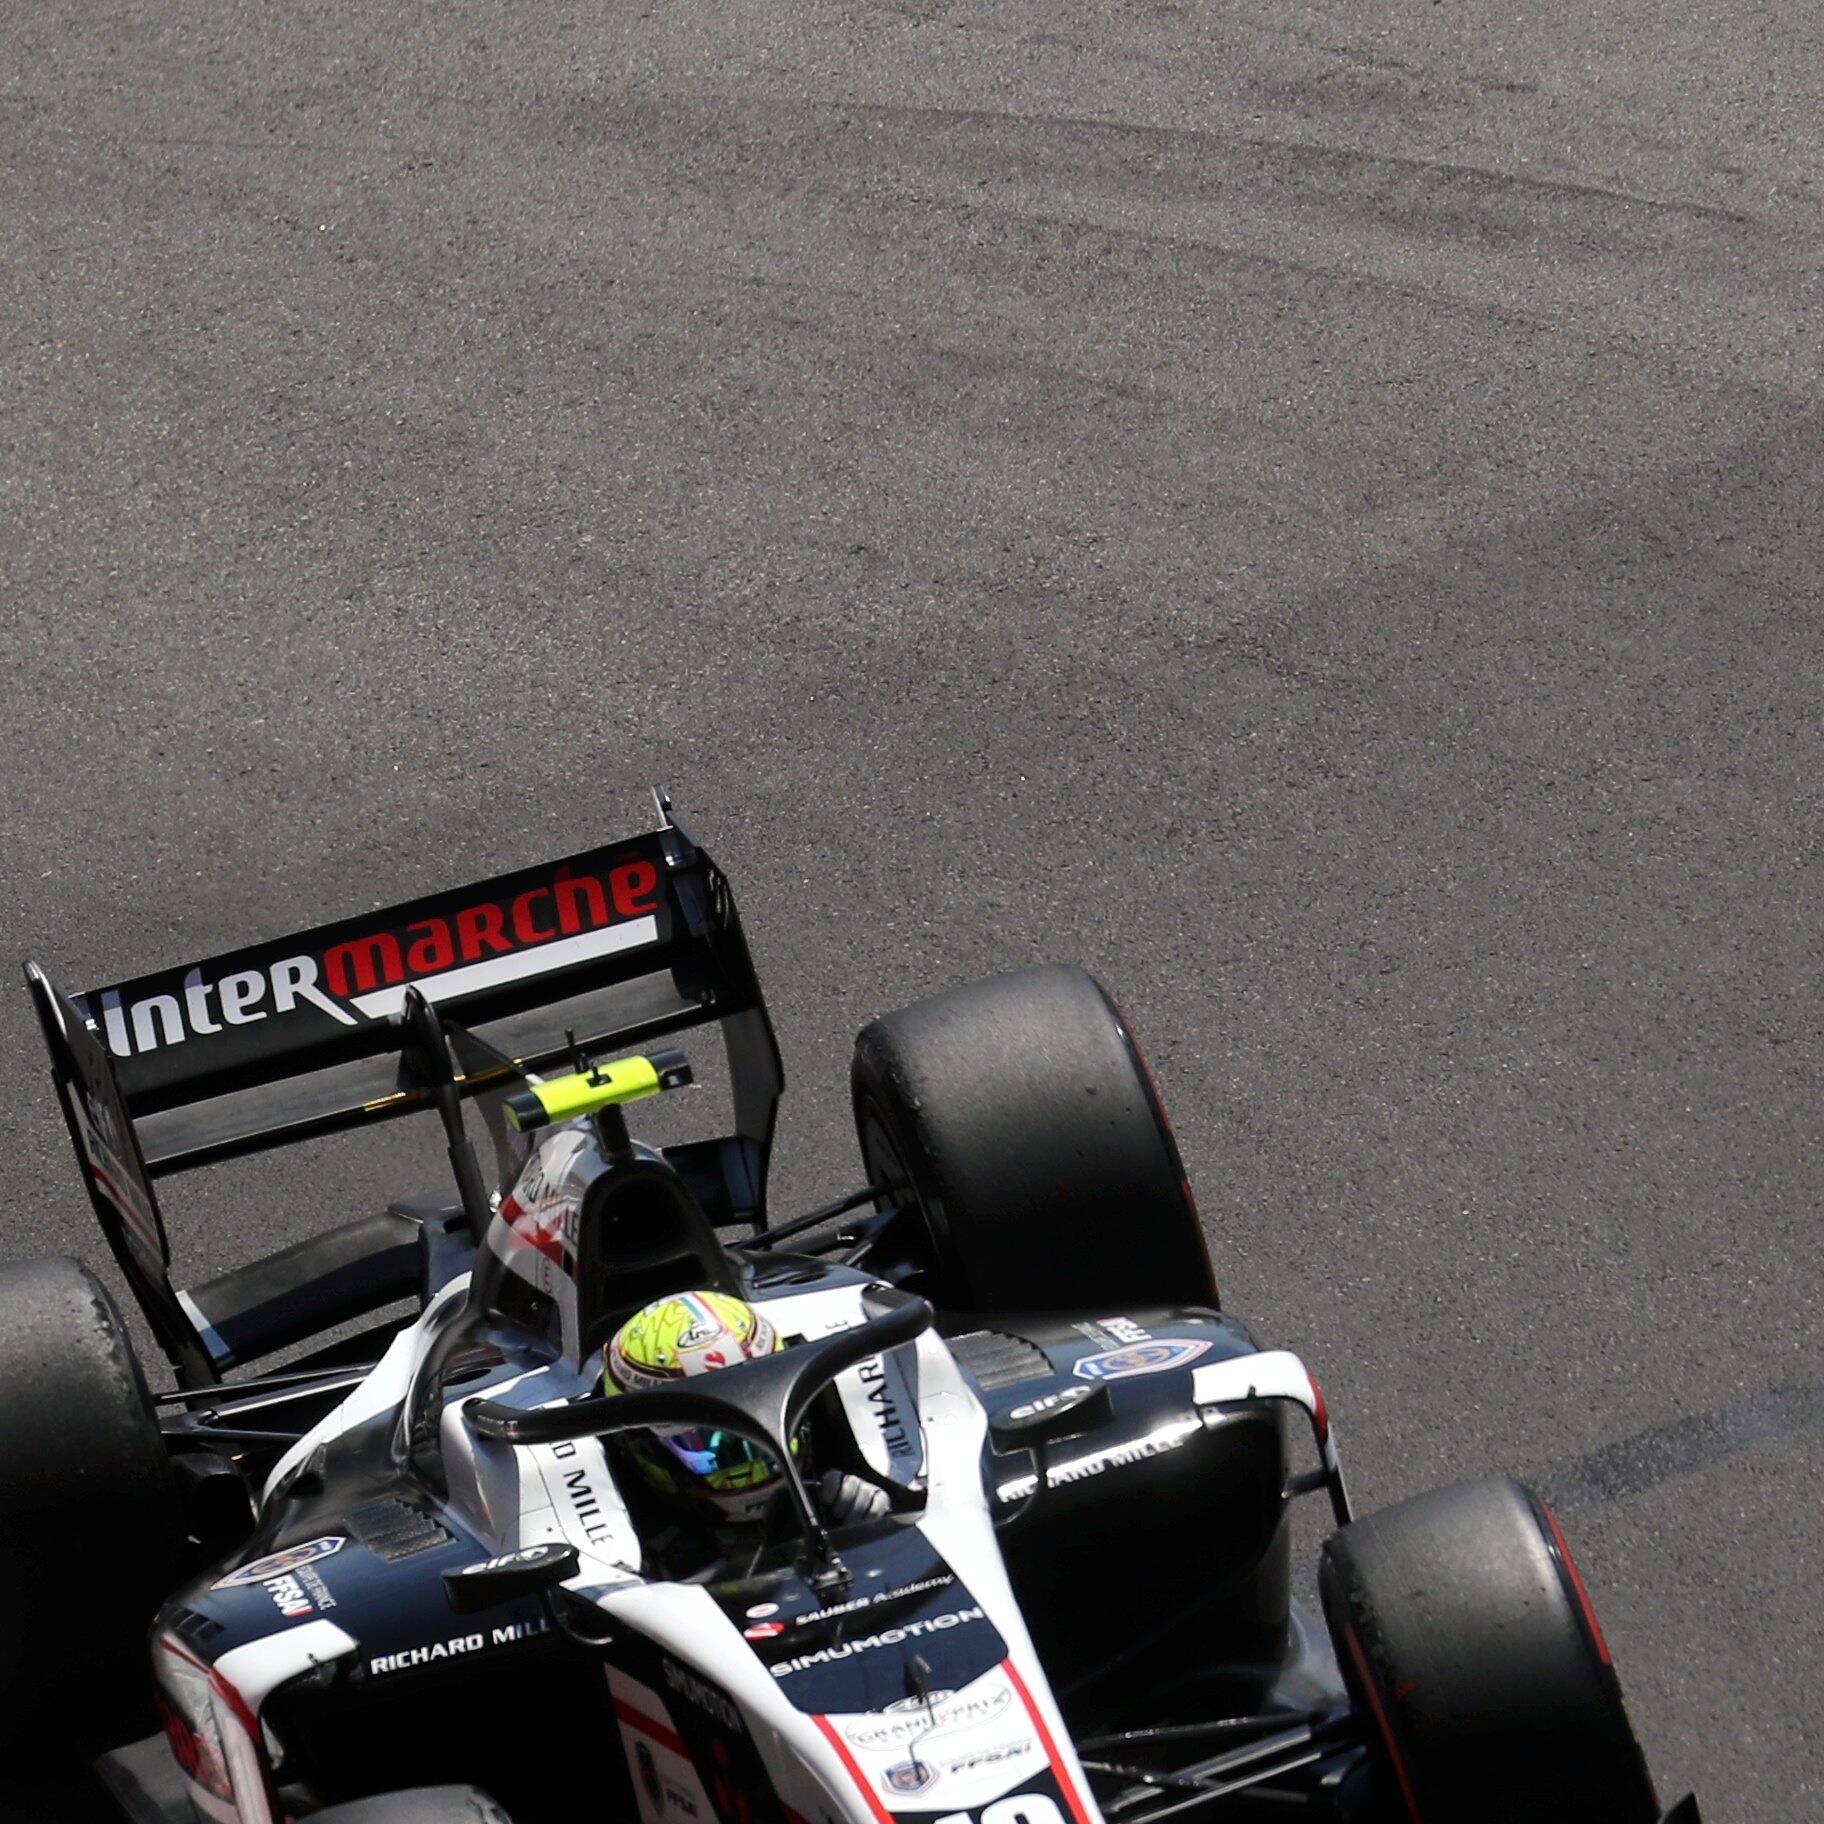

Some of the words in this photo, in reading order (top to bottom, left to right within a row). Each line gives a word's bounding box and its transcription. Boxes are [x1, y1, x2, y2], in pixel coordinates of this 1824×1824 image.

[858, 1356, 915, 1457] RICHAR
[563, 1469, 613, 1546] MILLE
[263, 1574, 312, 1616] FFSA
[795, 1597, 869, 1626] SAUBER
[370, 1632, 484, 1674] RICHARD
[492, 1617, 552, 1645] MILL
[769, 1606, 985, 1677] SIMUMOTION
